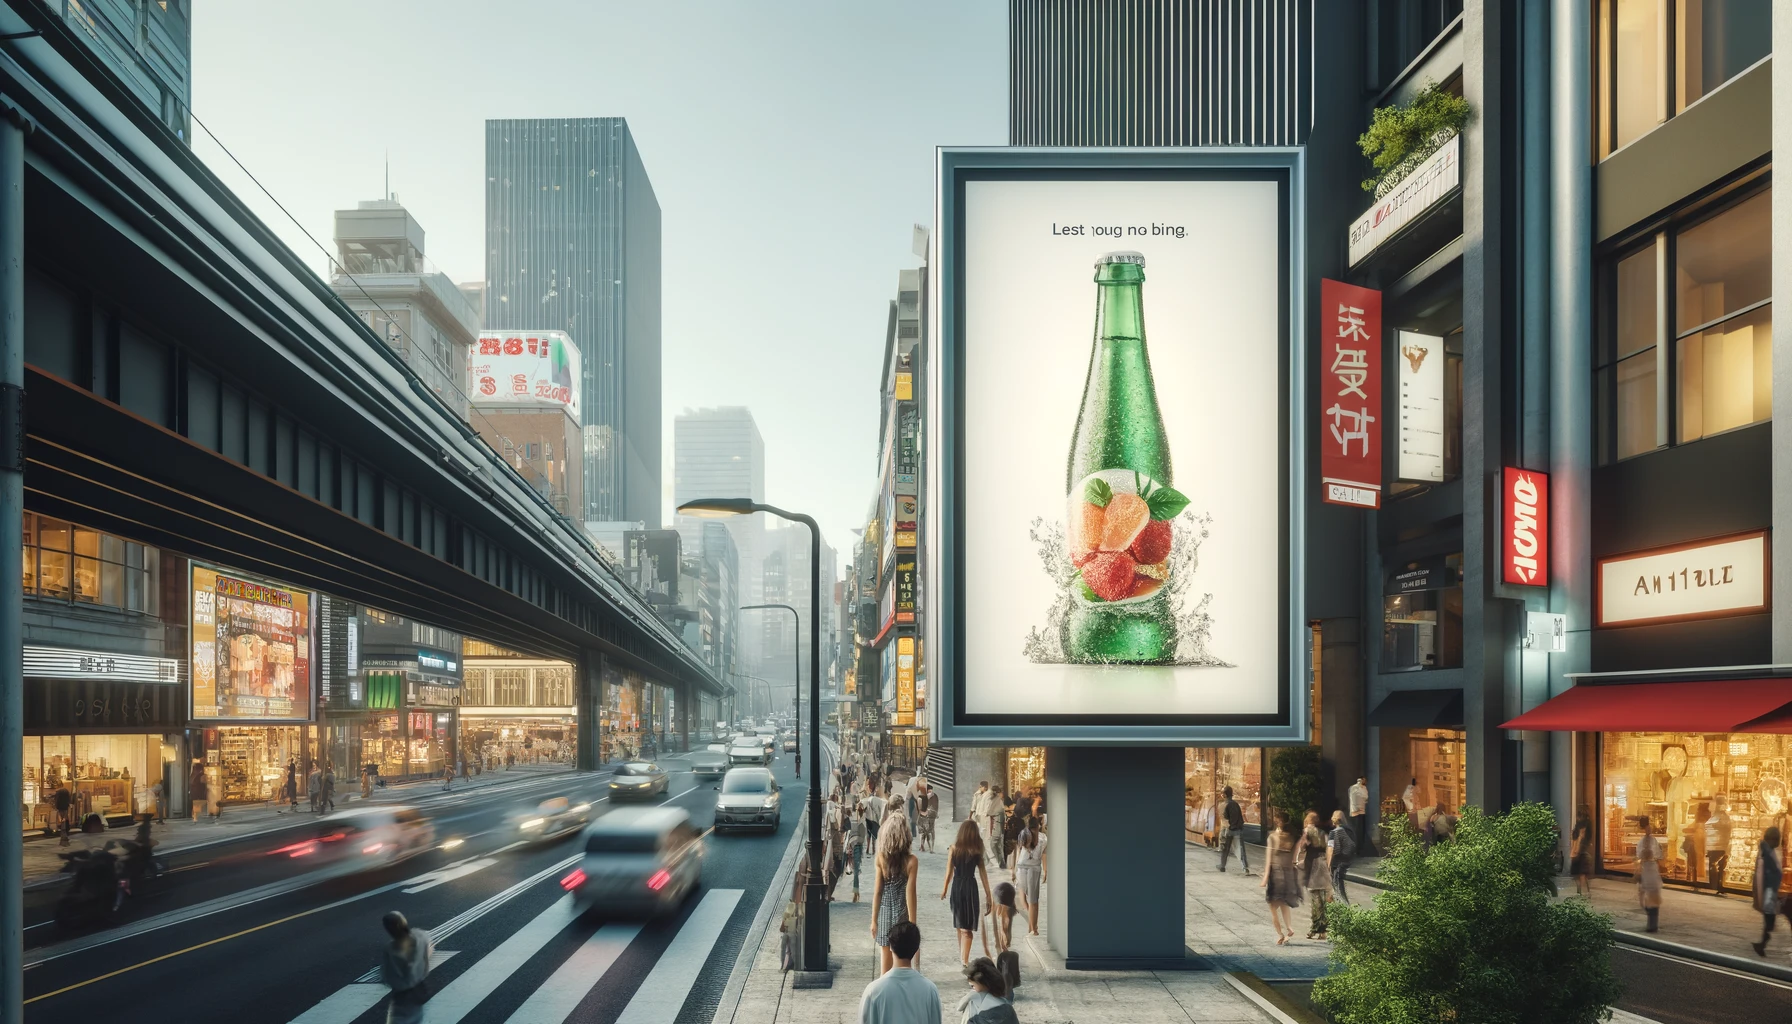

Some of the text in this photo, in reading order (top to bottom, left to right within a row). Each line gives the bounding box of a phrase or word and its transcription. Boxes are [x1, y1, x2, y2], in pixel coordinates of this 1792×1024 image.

[1053, 222, 1085, 236] Lest
[1128, 226, 1147, 236] no
[1152, 222, 1189, 239] bing.
